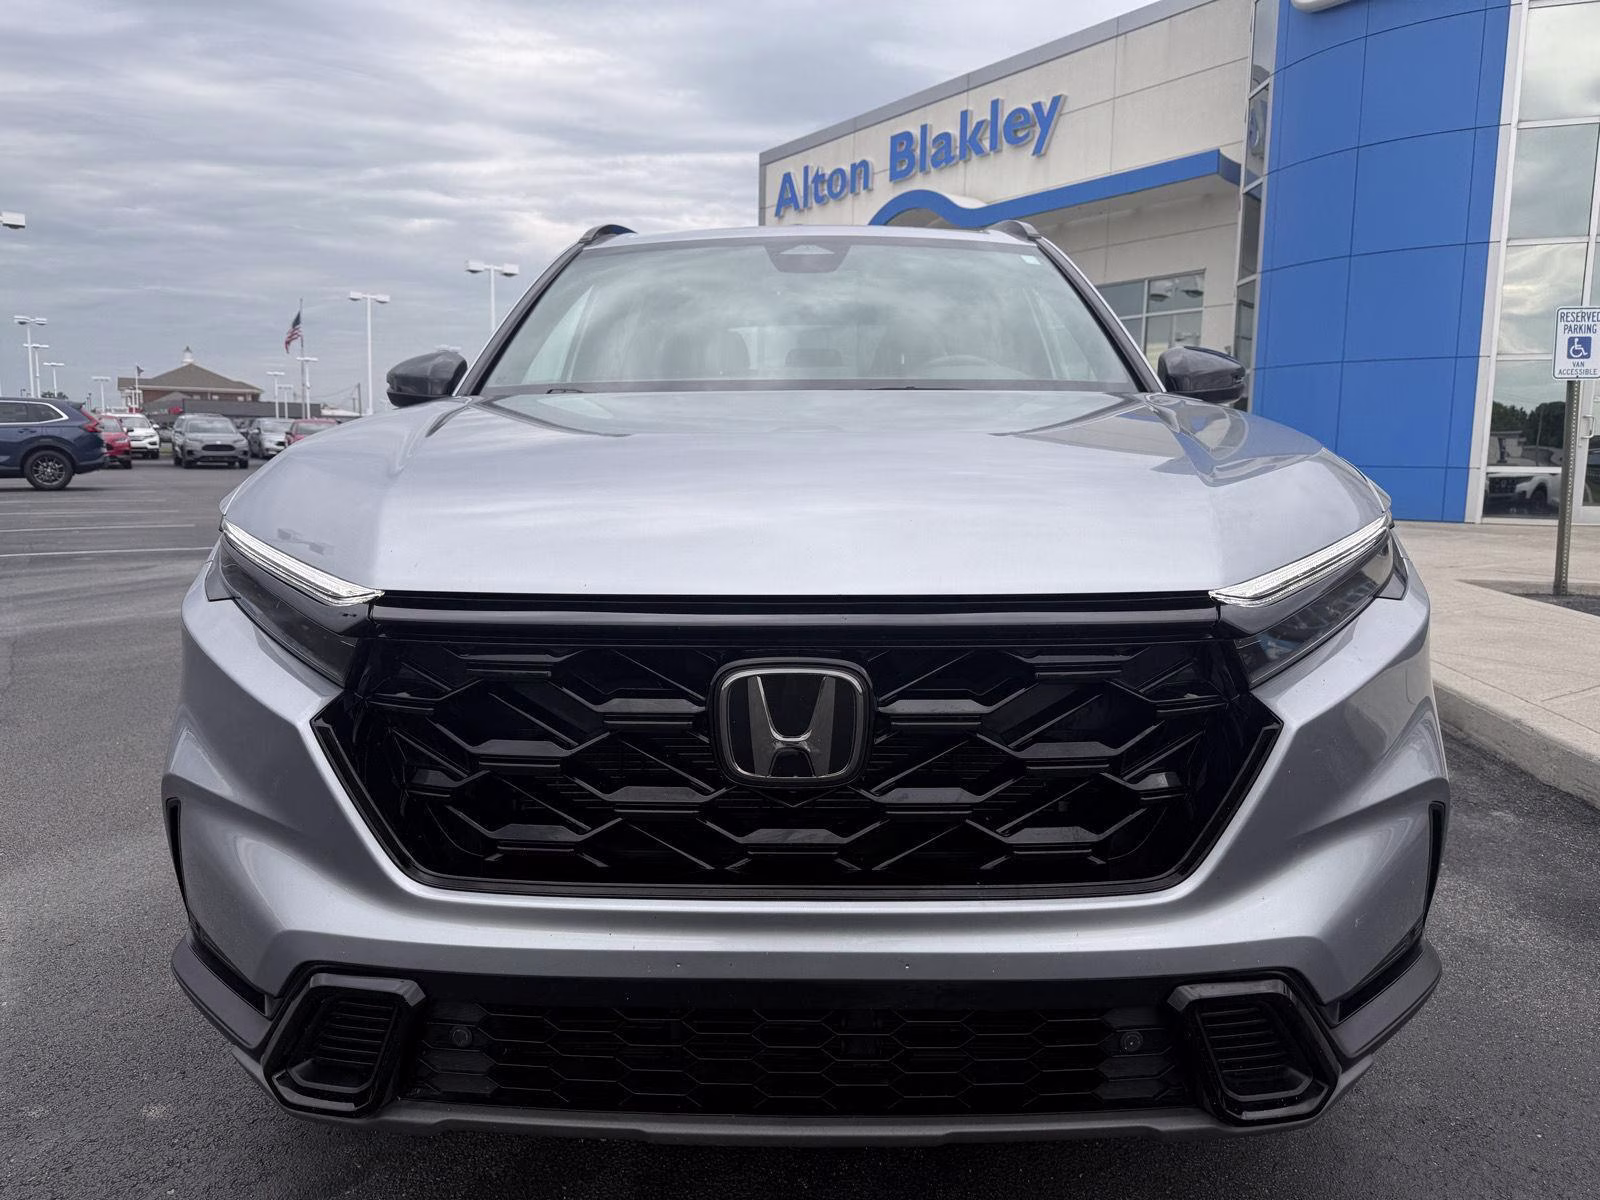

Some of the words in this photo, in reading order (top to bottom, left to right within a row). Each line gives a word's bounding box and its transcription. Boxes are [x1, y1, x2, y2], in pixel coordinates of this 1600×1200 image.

[774, 158, 873, 218] Alton
[889, 94, 1064, 182] Blakley
[1563, 324, 1597, 335] PARKING
[1558, 368, 1598, 376] ACCESSIBLE
